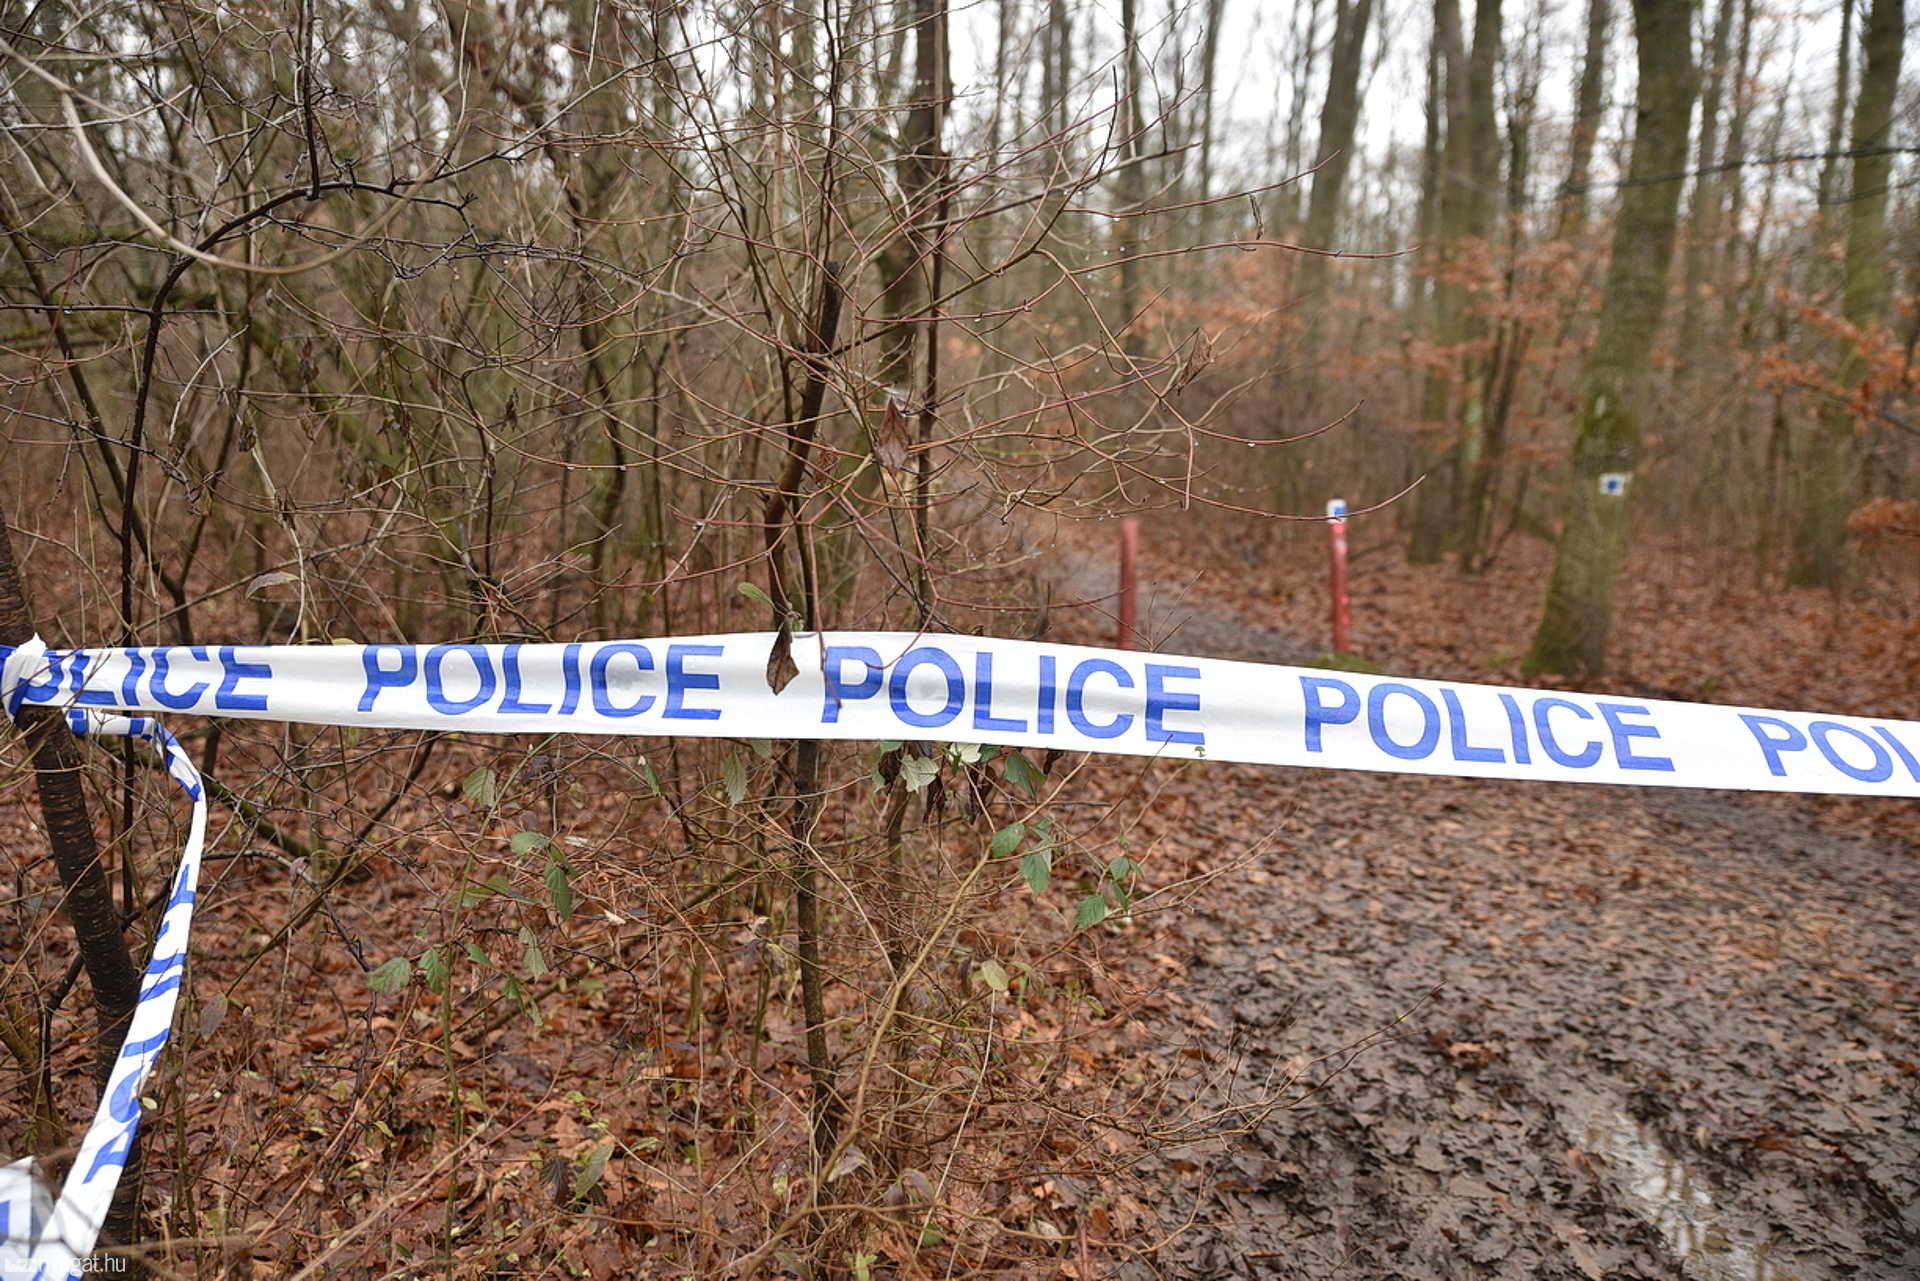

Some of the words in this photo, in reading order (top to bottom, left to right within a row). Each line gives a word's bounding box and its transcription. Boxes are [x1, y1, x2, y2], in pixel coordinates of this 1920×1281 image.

[10, 645, 273, 711] OLICE
[356, 643, 725, 720] POLICE
[820, 645, 1206, 746] POLICE
[1299, 675, 1676, 772] POLICE
